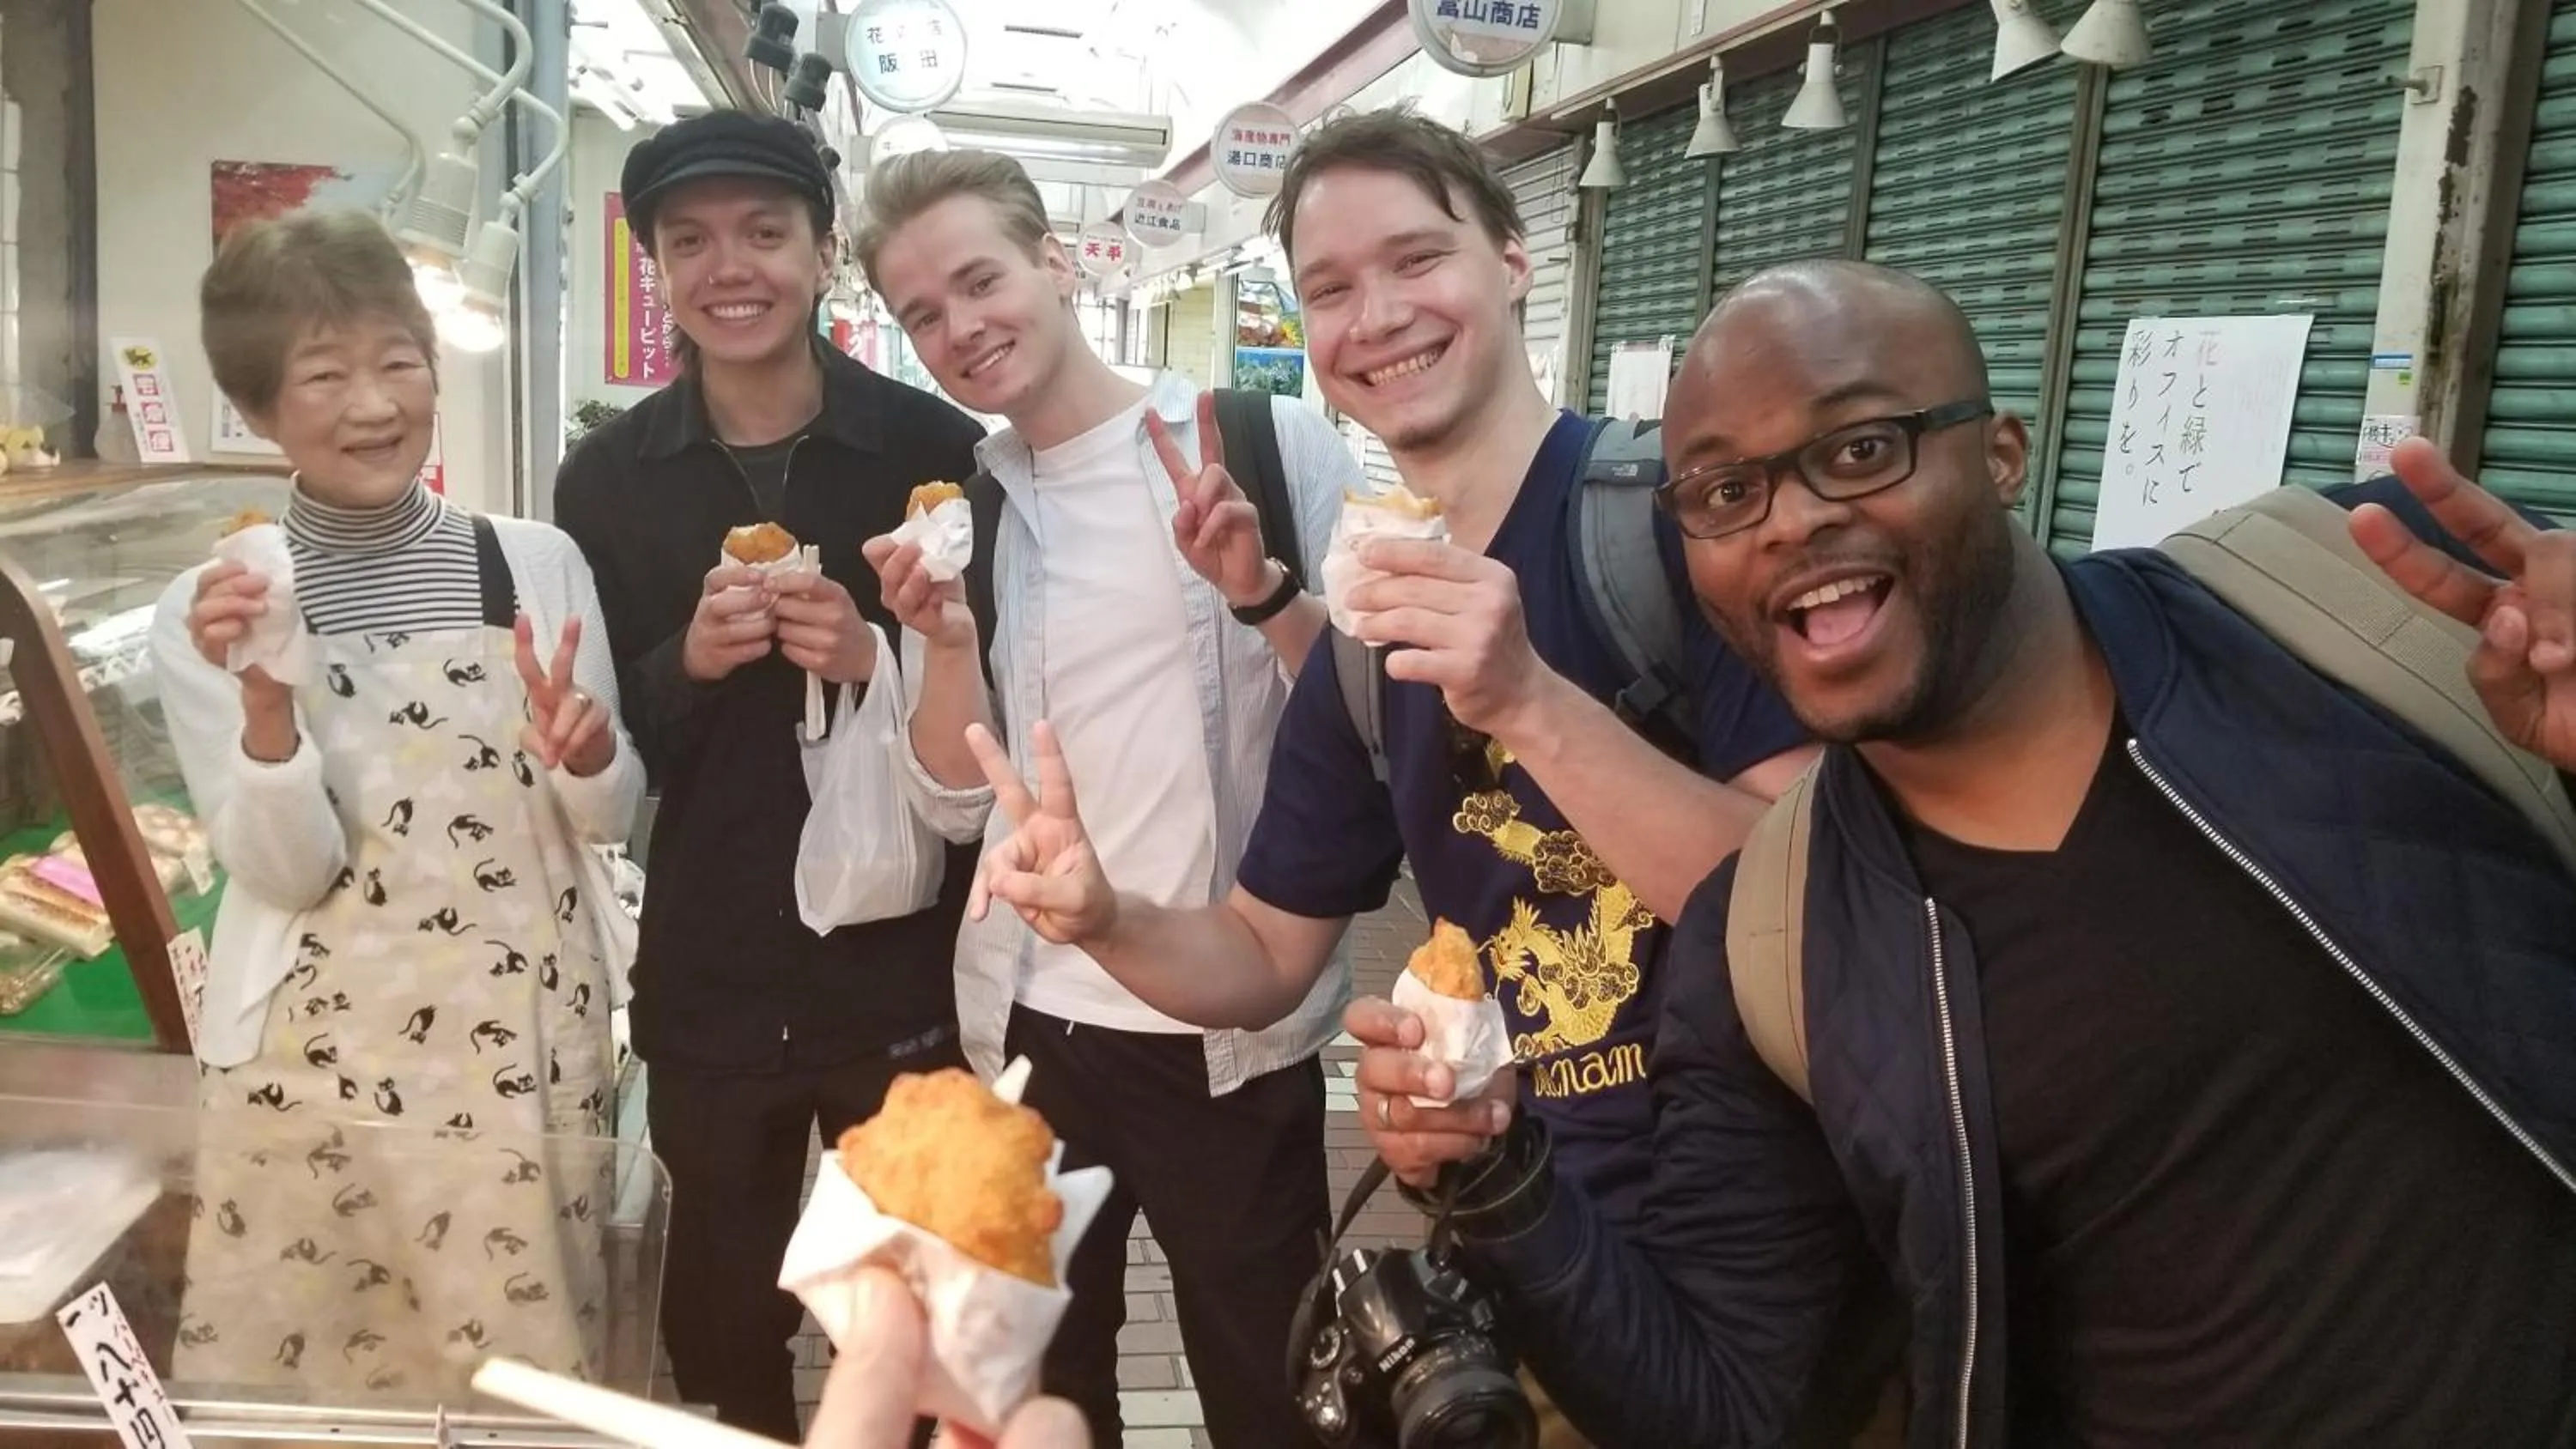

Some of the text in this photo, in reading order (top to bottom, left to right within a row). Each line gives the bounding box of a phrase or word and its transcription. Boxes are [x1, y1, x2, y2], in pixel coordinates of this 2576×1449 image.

[1437, 0, 1541, 29] 富山商店
[2178, 330, 2222, 493] 花と緑で
[1378, 1337, 1416, 1373] Nikon
